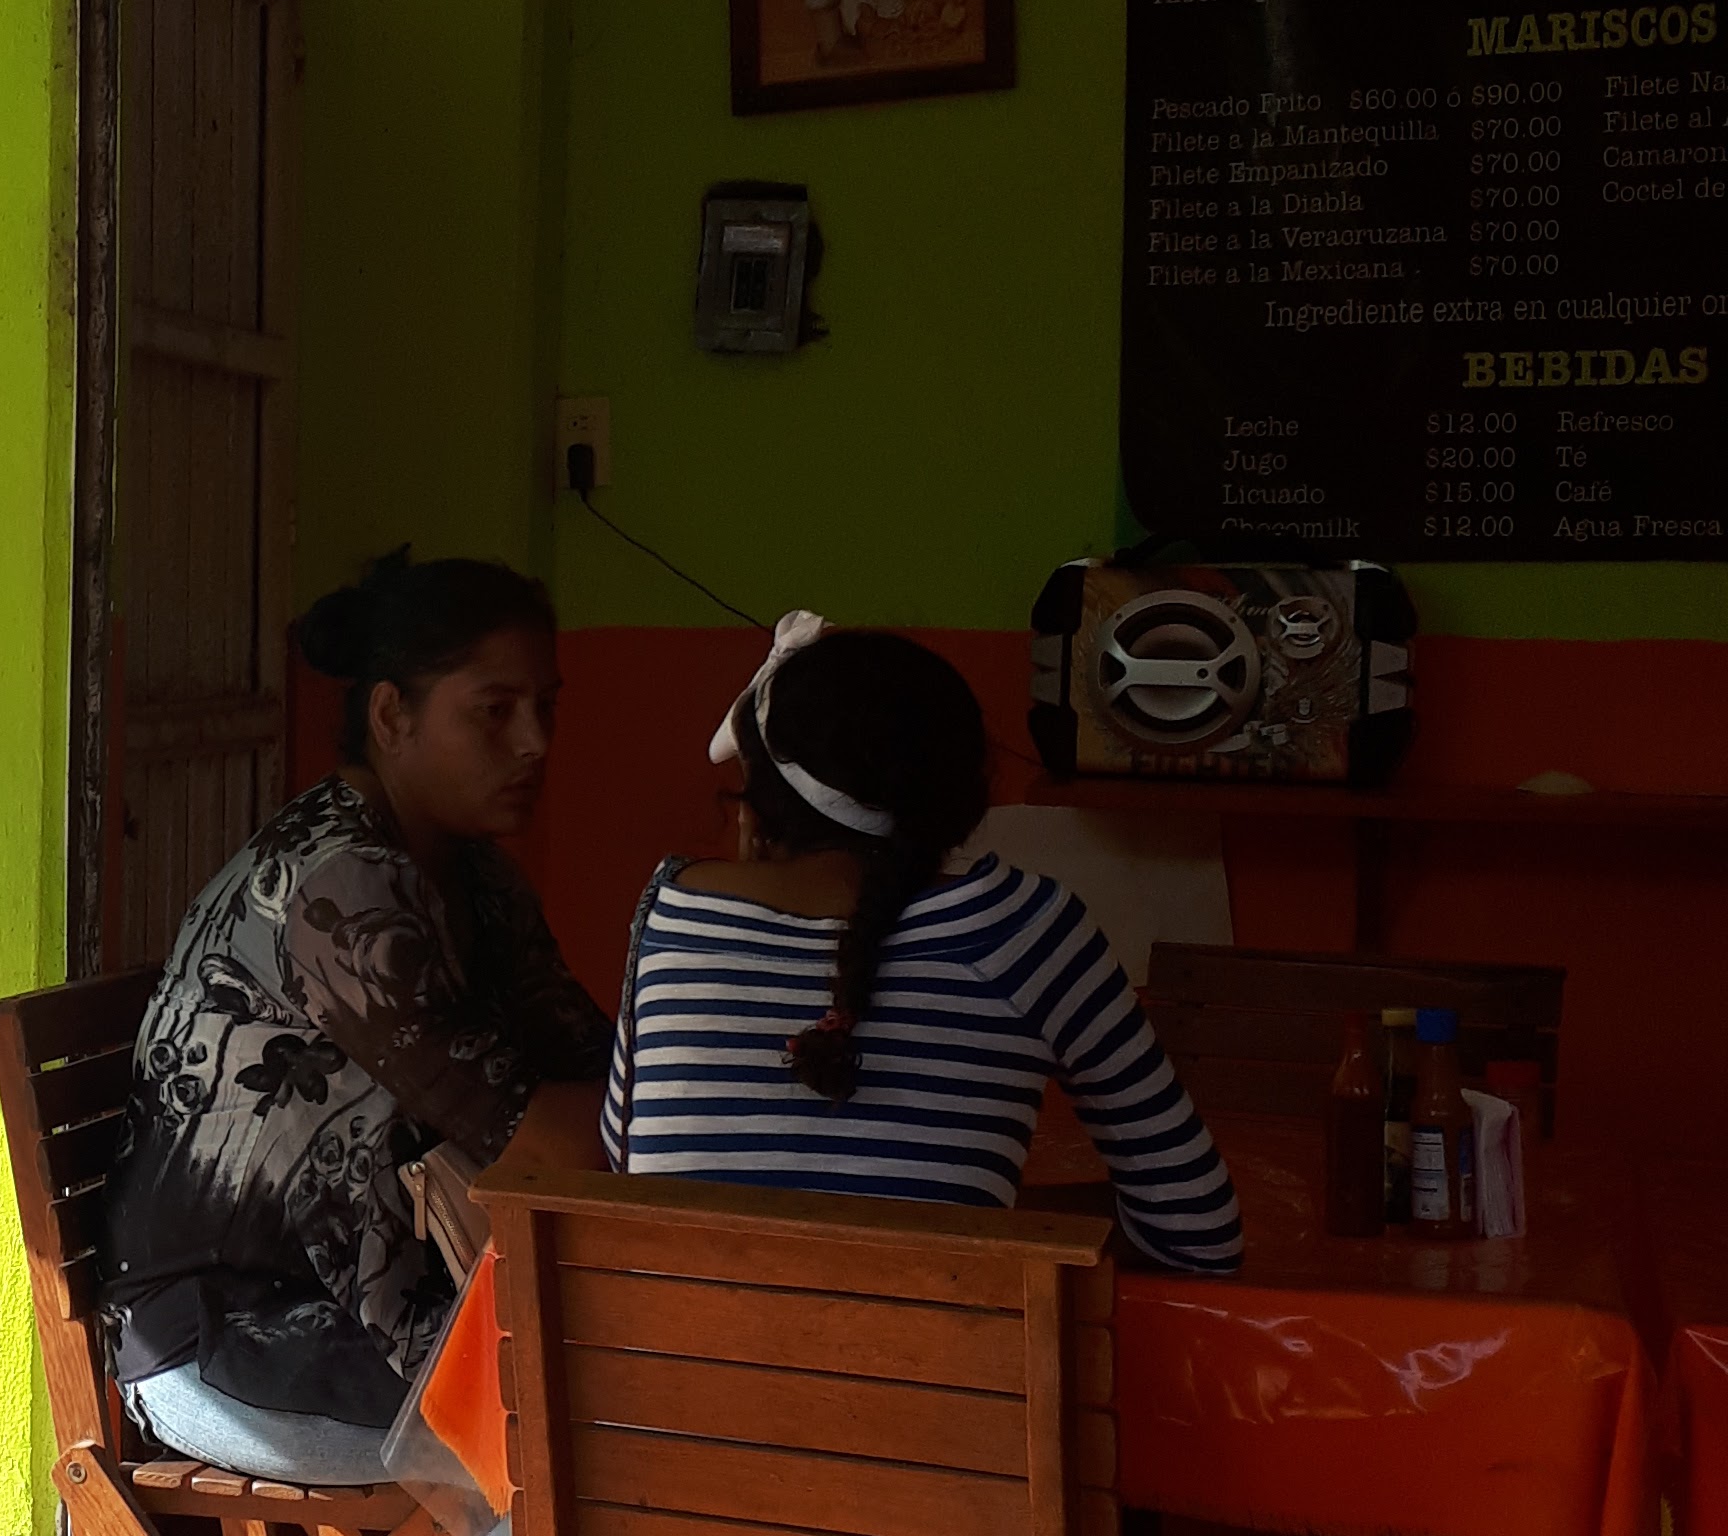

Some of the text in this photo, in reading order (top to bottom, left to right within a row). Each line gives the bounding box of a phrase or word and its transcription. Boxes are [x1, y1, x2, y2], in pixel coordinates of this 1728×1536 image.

[1467, 1, 1718, 57] MARISCOS
[1471, 81, 1562, 106] $90.00
[1605, 75, 1679, 98] Filete
[1152, 96, 1249, 120] Pescado
[1259, 93, 1321, 117] Frito
[1349, 88, 1437, 110] $60.00
[1471, 115, 1561, 141] $70.00
[1603, 111, 1678, 133] Filete
[1688, 106, 1712, 128] al
[1151, 120, 1439, 153] Filete a la Mantequilla
[1150, 155, 1388, 186] Filete Empanizado
[1470, 150, 1560, 175] $70.00
[1470, 184, 1560, 209] $70.00
[1602, 177, 1725, 202] Coctel de
[1149, 191, 1364, 220] Filete a la Diabla
[1148, 226, 1447, 252] Filete a la Veracruzana
[1470, 219, 1559, 242] $70.00
[1148, 260, 1404, 286] Filete a la Mexicana
[1469, 254, 1559, 276] $70.00
[1265, 299, 1424, 332] Ingrediente
[1433, 298, 1504, 322] extra
[1514, 300, 1547, 320] en
[1557, 292, 1691, 325] cualquier
[1462, 346, 1710, 389] BEBIDAS
[1224, 416, 1299, 437] Leche
[1427, 412, 1517, 434] $12.00
[1557, 411, 1673, 432] Refresco
[1223, 450, 1287, 475] Jugo
[1426, 447, 1516, 469] $20.00
[1556, 446, 1587, 467] Té
[1223, 484, 1325, 504] Licuado
[1425, 481, 1515, 503] $15.00
[1555, 481, 1612, 502] Café
[1424, 516, 1514, 537] $12.00
[1553, 515, 1723, 542] Agua Fresca
